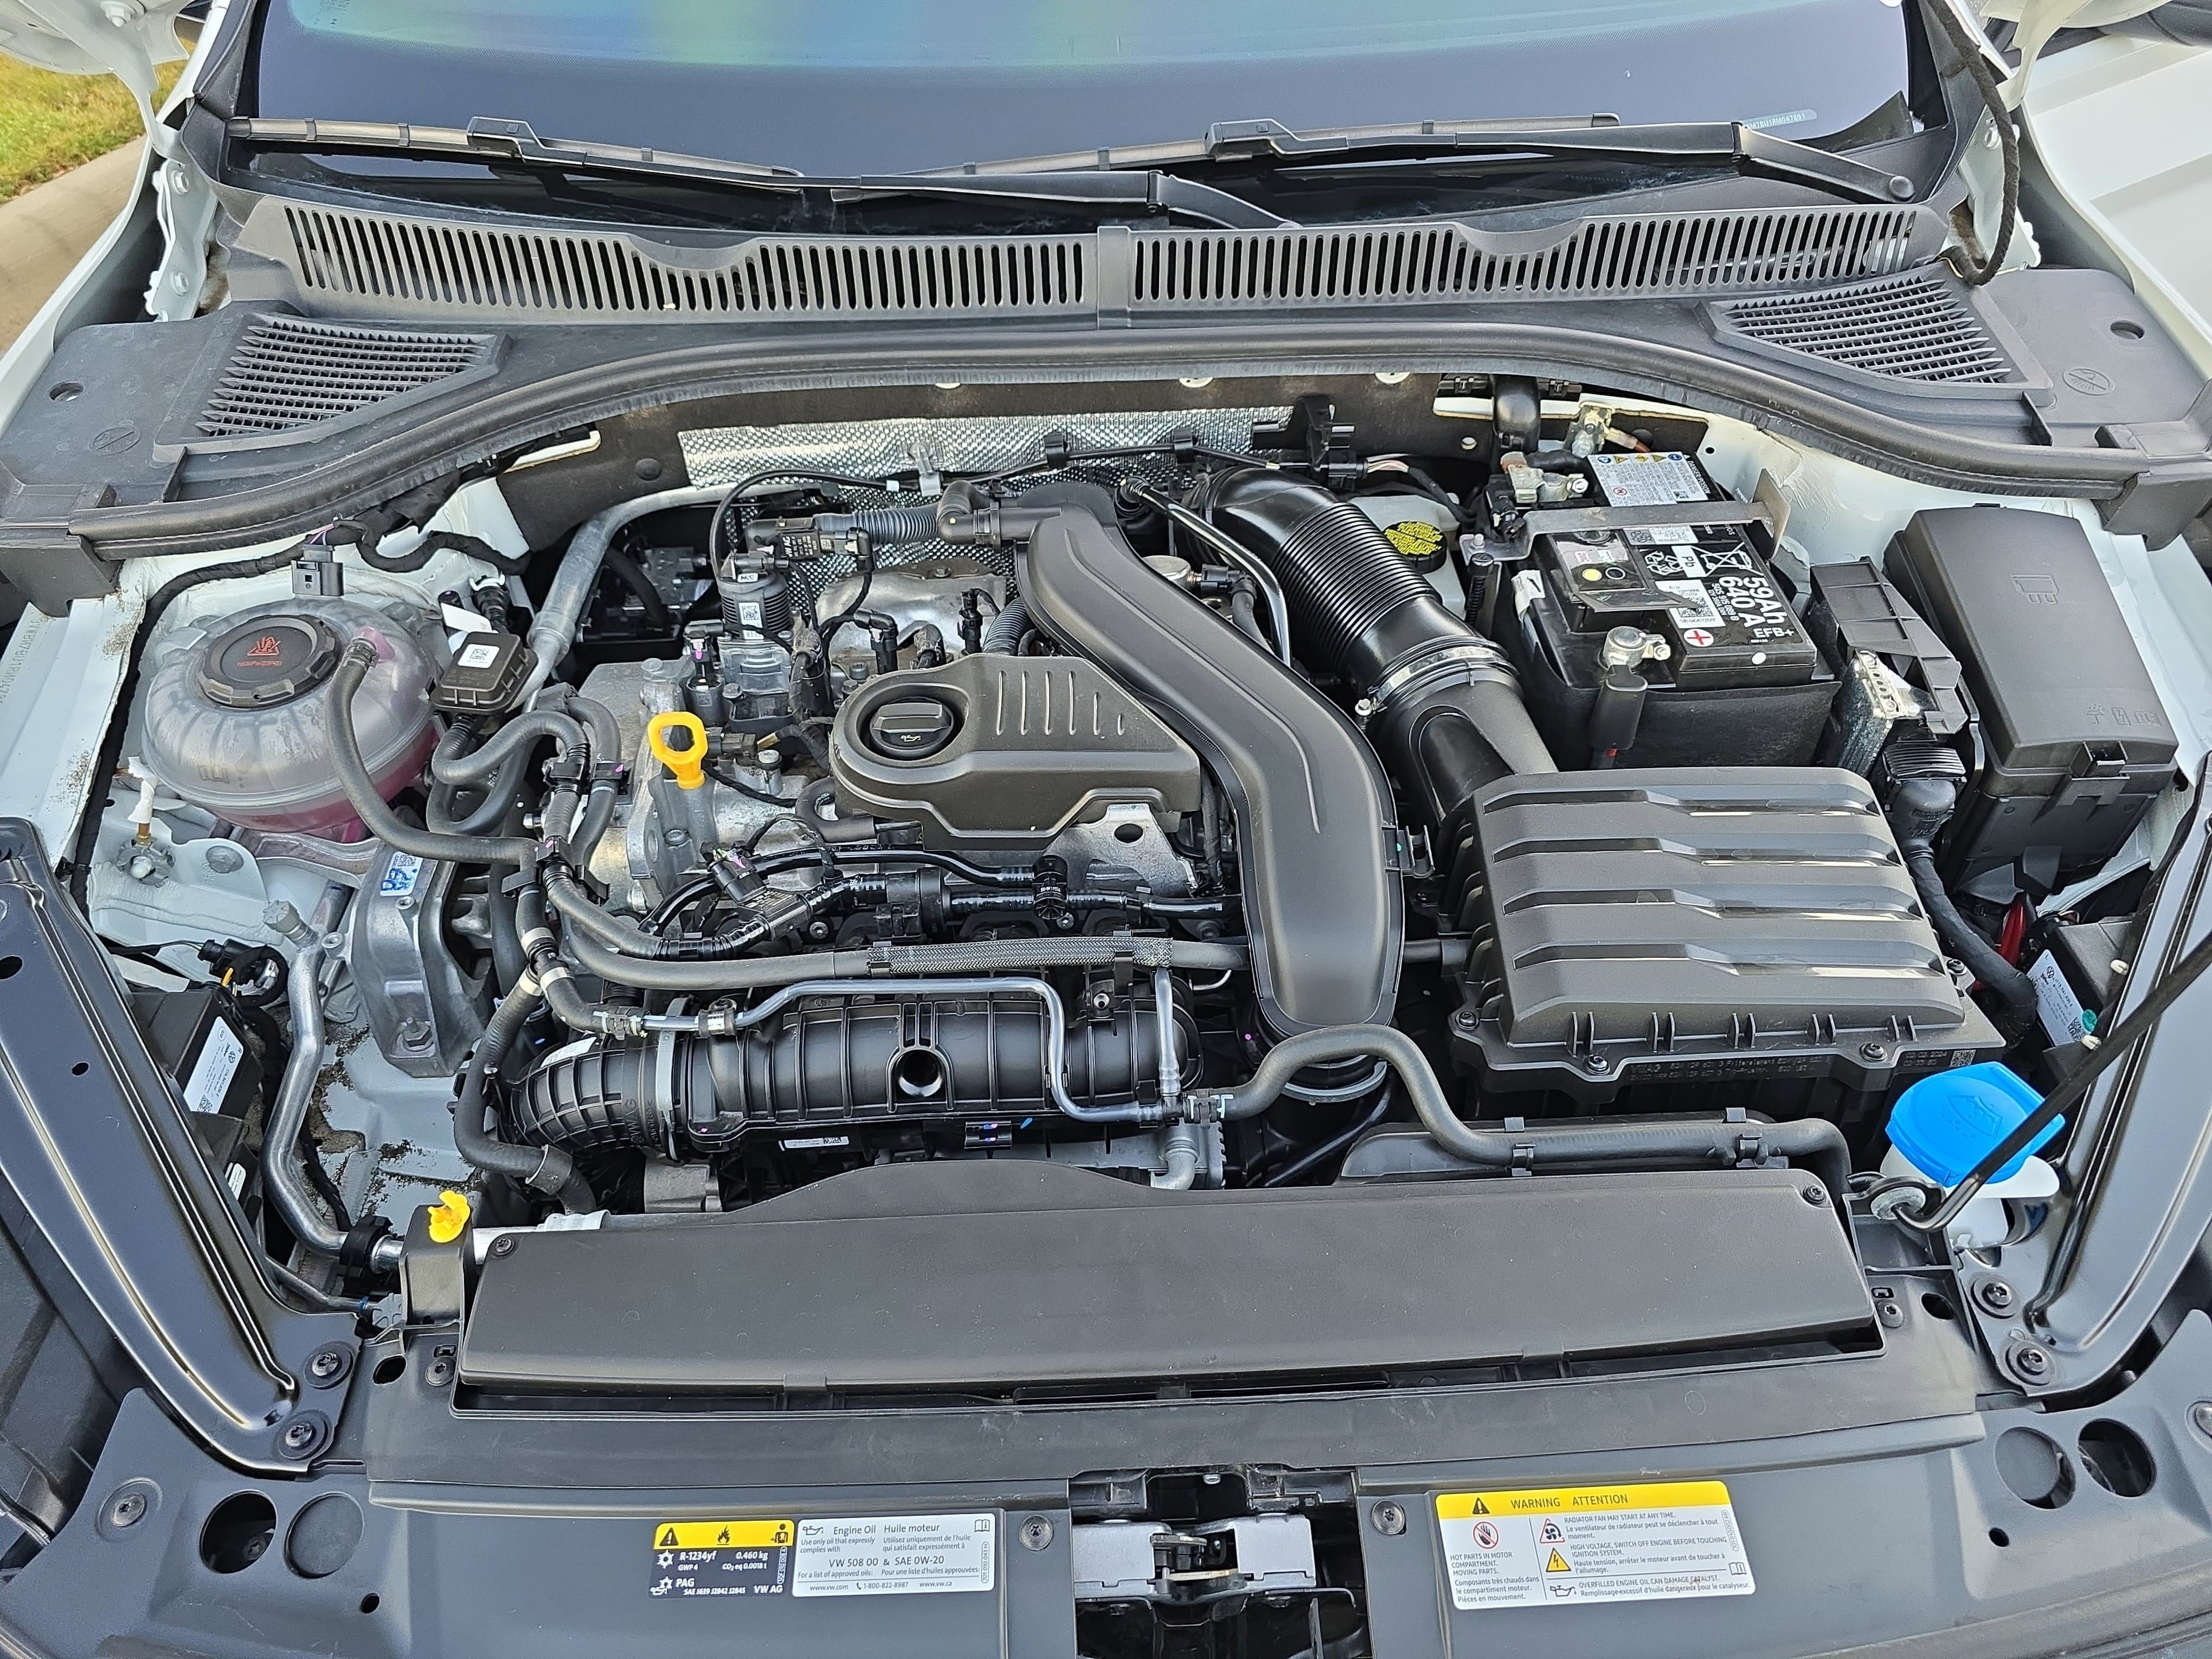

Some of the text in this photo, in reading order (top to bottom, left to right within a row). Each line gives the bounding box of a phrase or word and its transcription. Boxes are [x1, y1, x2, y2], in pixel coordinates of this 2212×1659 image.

[1682, 556, 1695, 568] Pb
[1719, 576, 1756, 608] 640
[1738, 613, 1766, 628] A
[1743, 577, 1788, 624] 59Ah
[1753, 627, 1795, 638] EFB+
[1510, 1494, 1629, 1509] WARNING ATTENTION
[1667, 1519, 1699, 1527] déclencher
[833, 1525, 876, 1536] Engine Oil
[884, 1523, 940, 1533] Huile moteur
[813, 1538, 826, 1546] only
[848, 1536, 876, 1545] expressly
[906, 1535, 943, 1544] uniquement
[1696, 1536, 1727, 1544] TOUCHING
[800, 1546, 826, 1554] complies
[883, 1545, 892, 1553] qui
[918, 1542, 960, 1552] expressément
[680, 1551, 768, 1562] R-1234yf 0.460 kg
[1572, 1549, 1598, 1558] IGNITION
[829, 1558, 845, 1567] VW
[847, 1558, 864, 1567] 508
[866, 1558, 878, 1566] 00
[895, 1557, 912, 1566] SAE
[914, 1555, 944, 1565] 0W-20
[1451, 1560, 1499, 1568] COMPARTMENT.
[831, 1570, 859, 1579] approved
[944, 1566, 980, 1575] approuvées:
[1453, 1568, 1477, 1577] MOVING
[676, 1578, 695, 1587] PAG
[1455, 1578, 1491, 1587] Composants
[754, 1585, 783, 1593] VW AG
[1463, 1586, 1507, 1595] compartiment
[1458, 1595, 1477, 1603] Pièces
